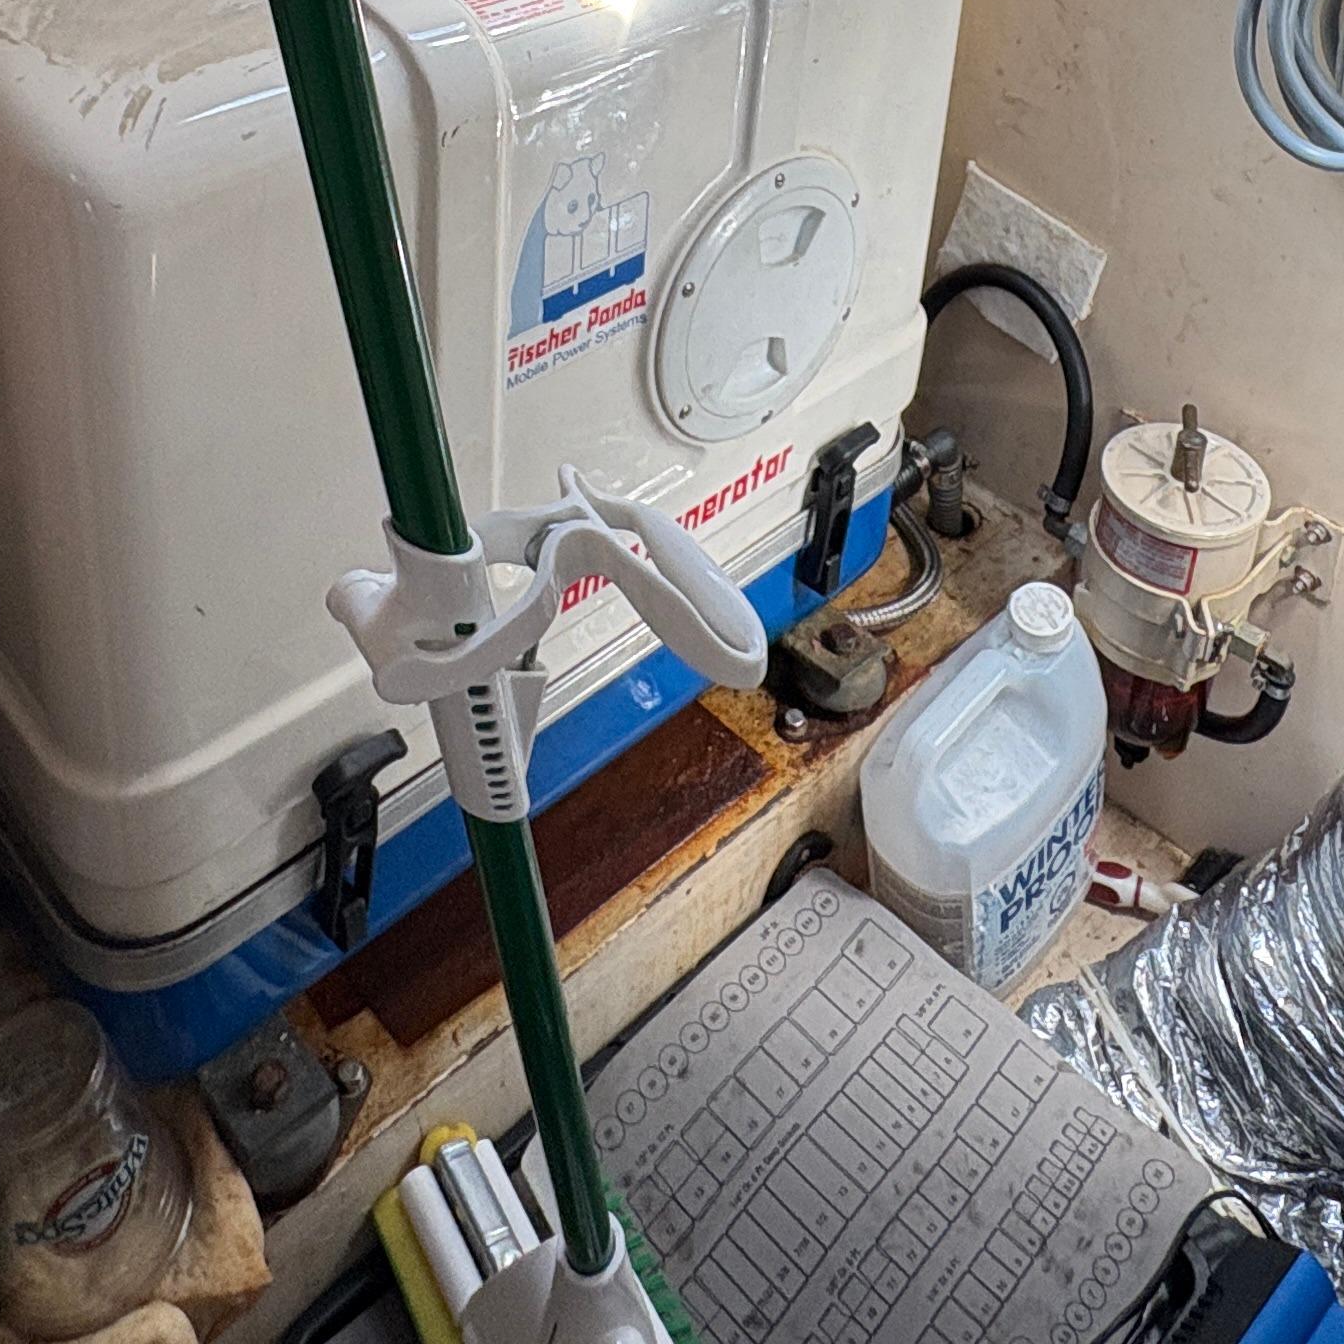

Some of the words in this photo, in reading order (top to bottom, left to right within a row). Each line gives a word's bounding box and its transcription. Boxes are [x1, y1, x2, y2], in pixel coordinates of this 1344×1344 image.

[506, 361, 548, 390] Mobile
[552, 338, 592, 366] Power
[595, 313, 648, 344] Systems
[508, 321, 582, 372] Fischer
[587, 288, 646, 332] Panda
[675, 444, 794, 532] nerator
[1001, 792, 1100, 934] PROO
